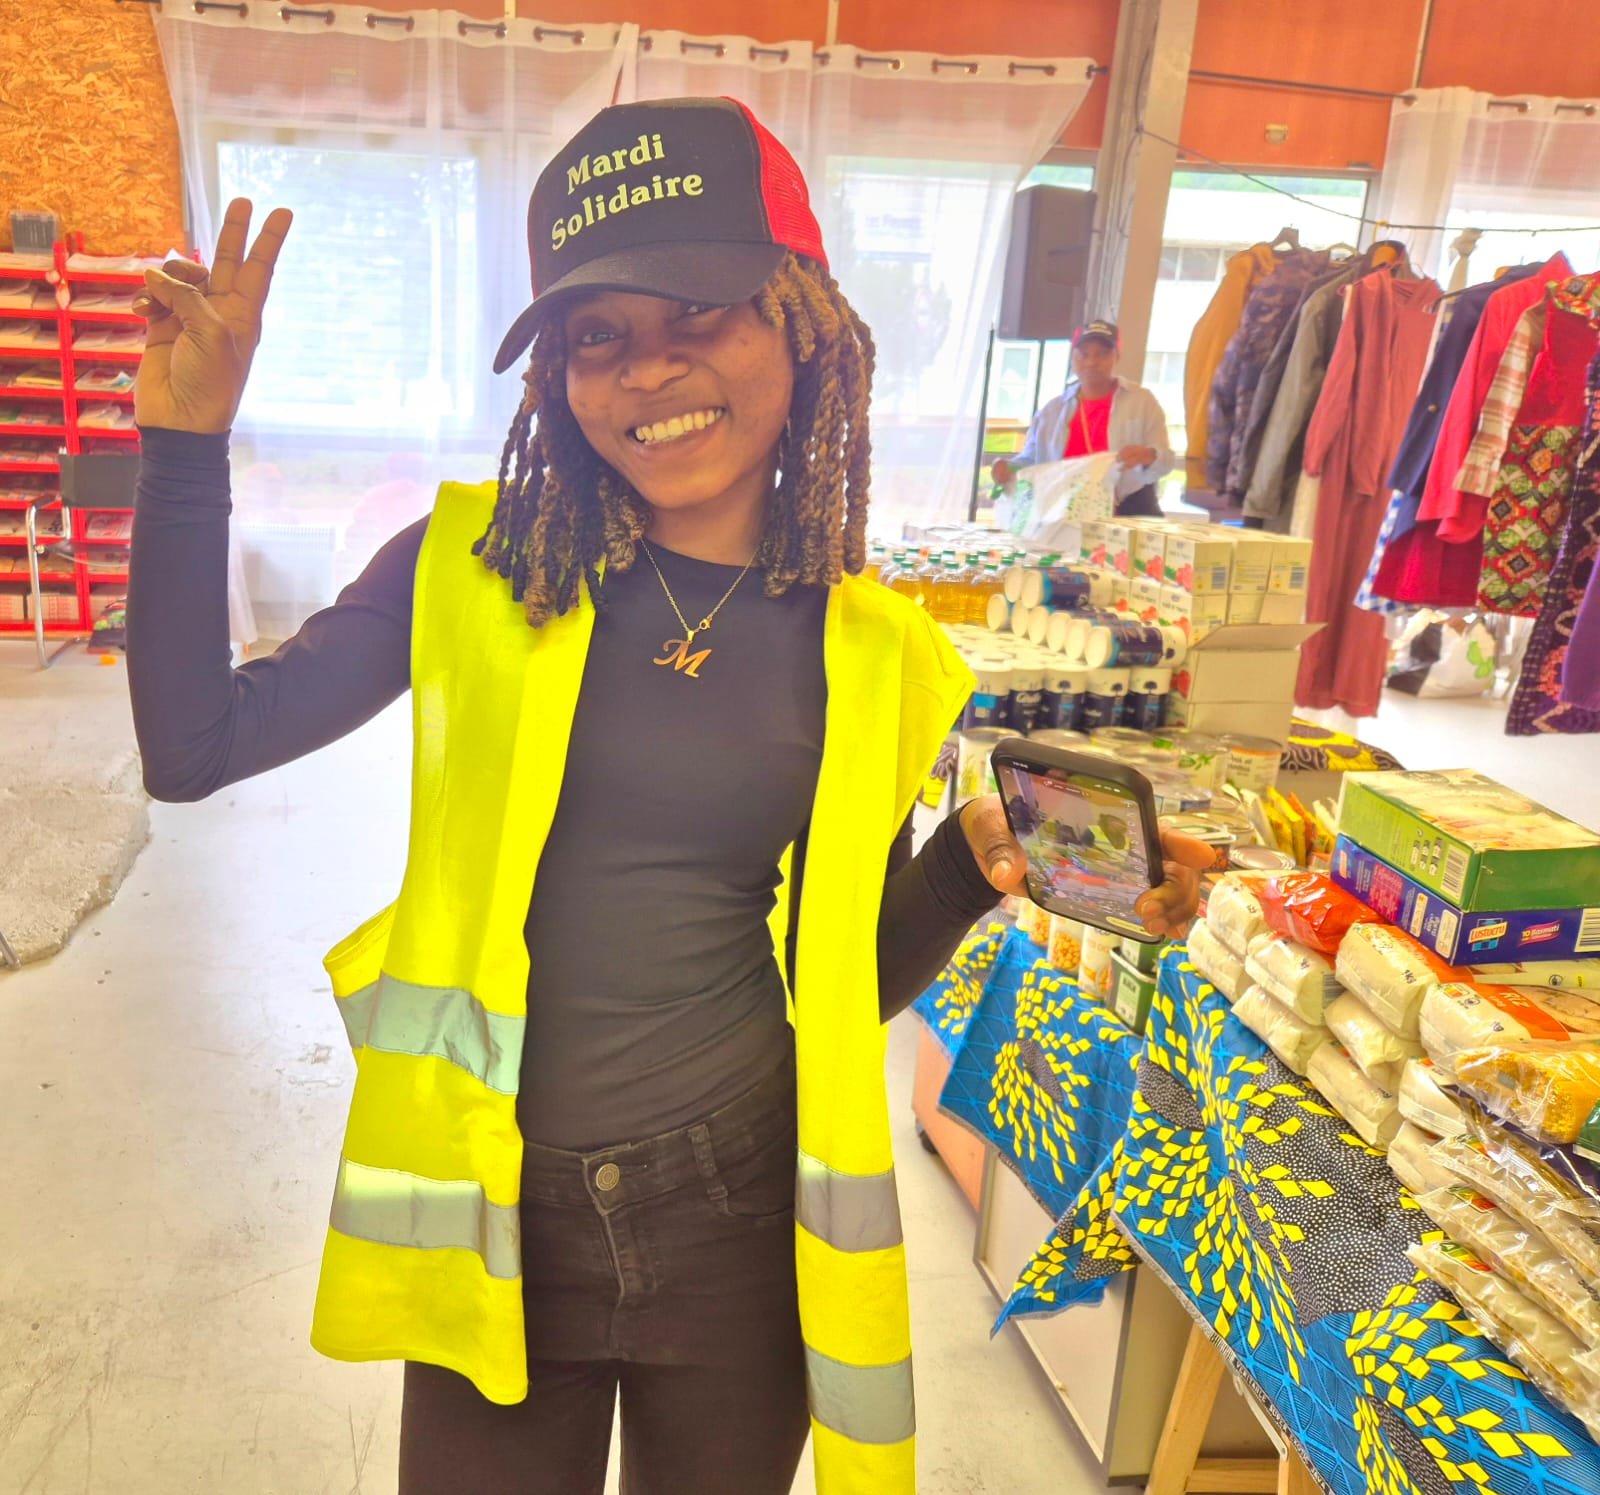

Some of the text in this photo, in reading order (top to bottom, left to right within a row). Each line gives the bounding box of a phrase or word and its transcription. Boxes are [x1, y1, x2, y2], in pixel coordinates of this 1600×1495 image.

[566, 133, 665, 195] Mardi
[551, 173, 704, 251] Solidaire
[653, 639, 712, 678] M
